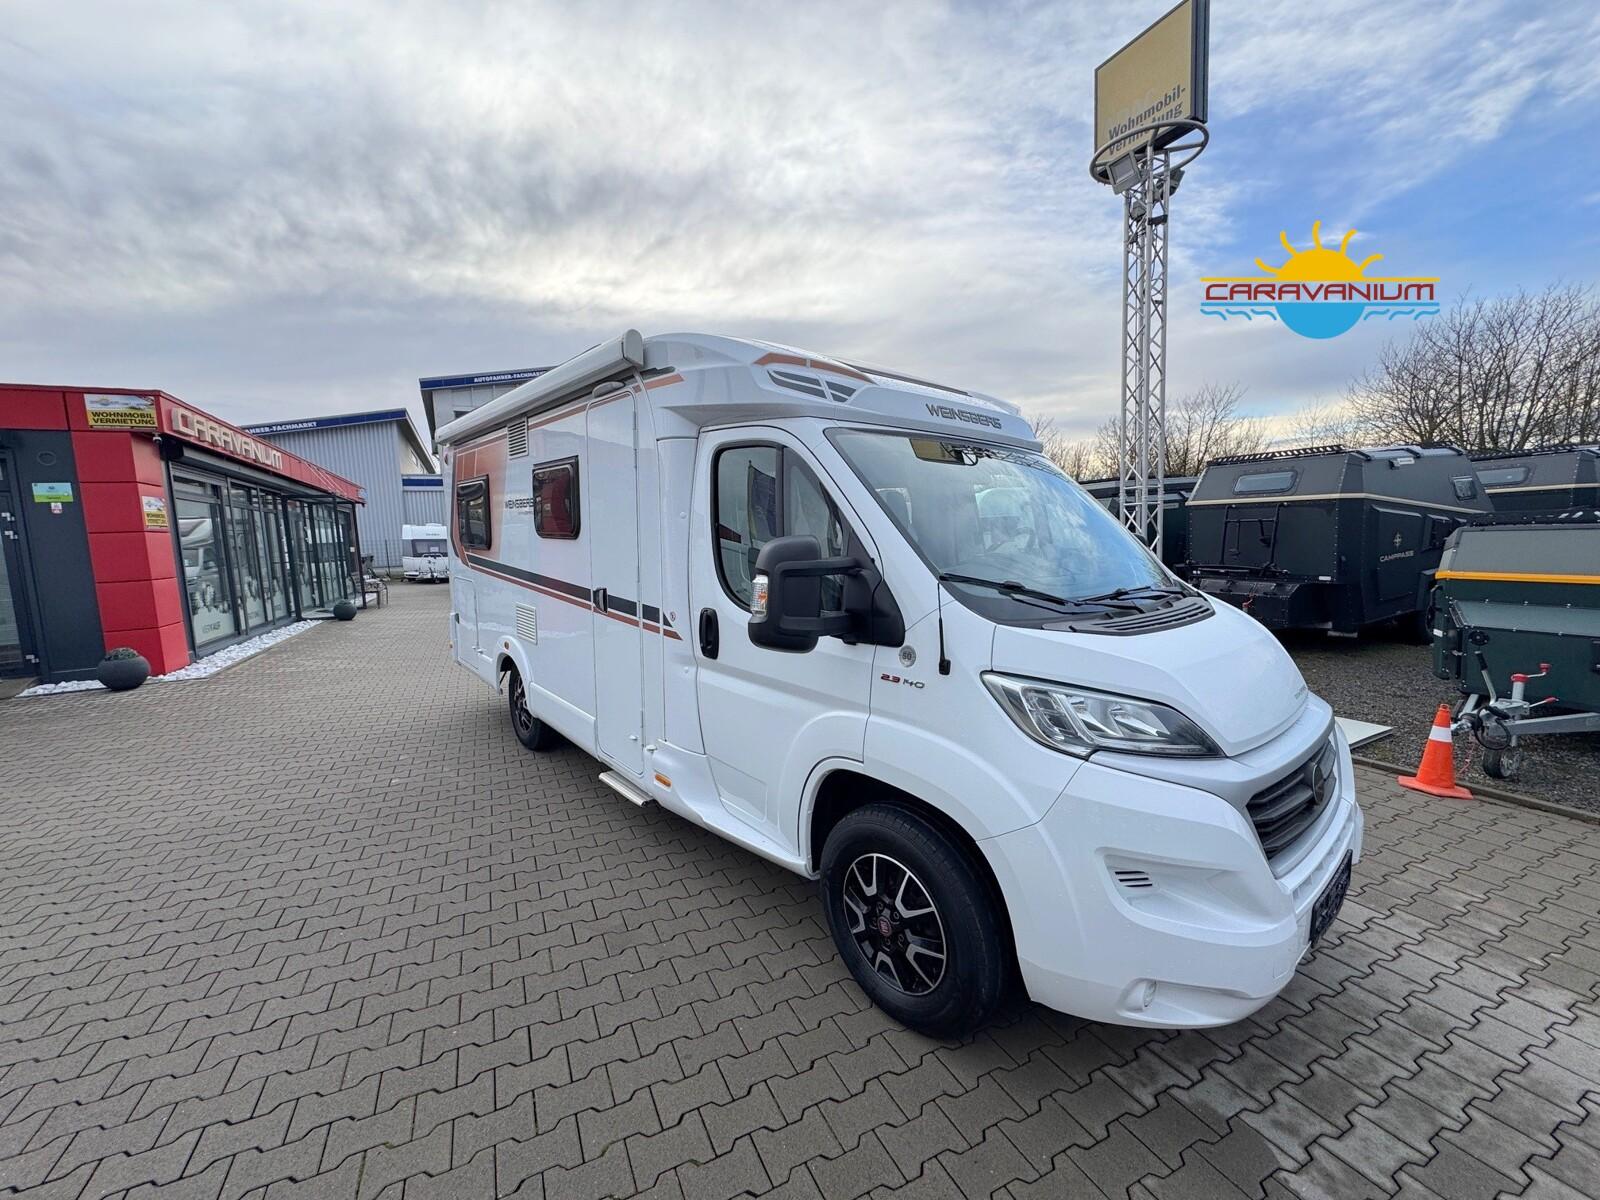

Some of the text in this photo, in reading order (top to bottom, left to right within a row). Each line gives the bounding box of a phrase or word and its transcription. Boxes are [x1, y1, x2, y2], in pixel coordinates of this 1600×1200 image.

[1109, 84, 1186, 139] Wohnmobil-
[1109, 101, 1184, 156] Vermitung
[91, 411, 155, 419] WOHNMOBIL
[92, 417, 156, 425] VERMIETUNG
[925, 403, 1002, 429] WEINSBERG
[172, 407, 283, 470] CARAVANIUM
